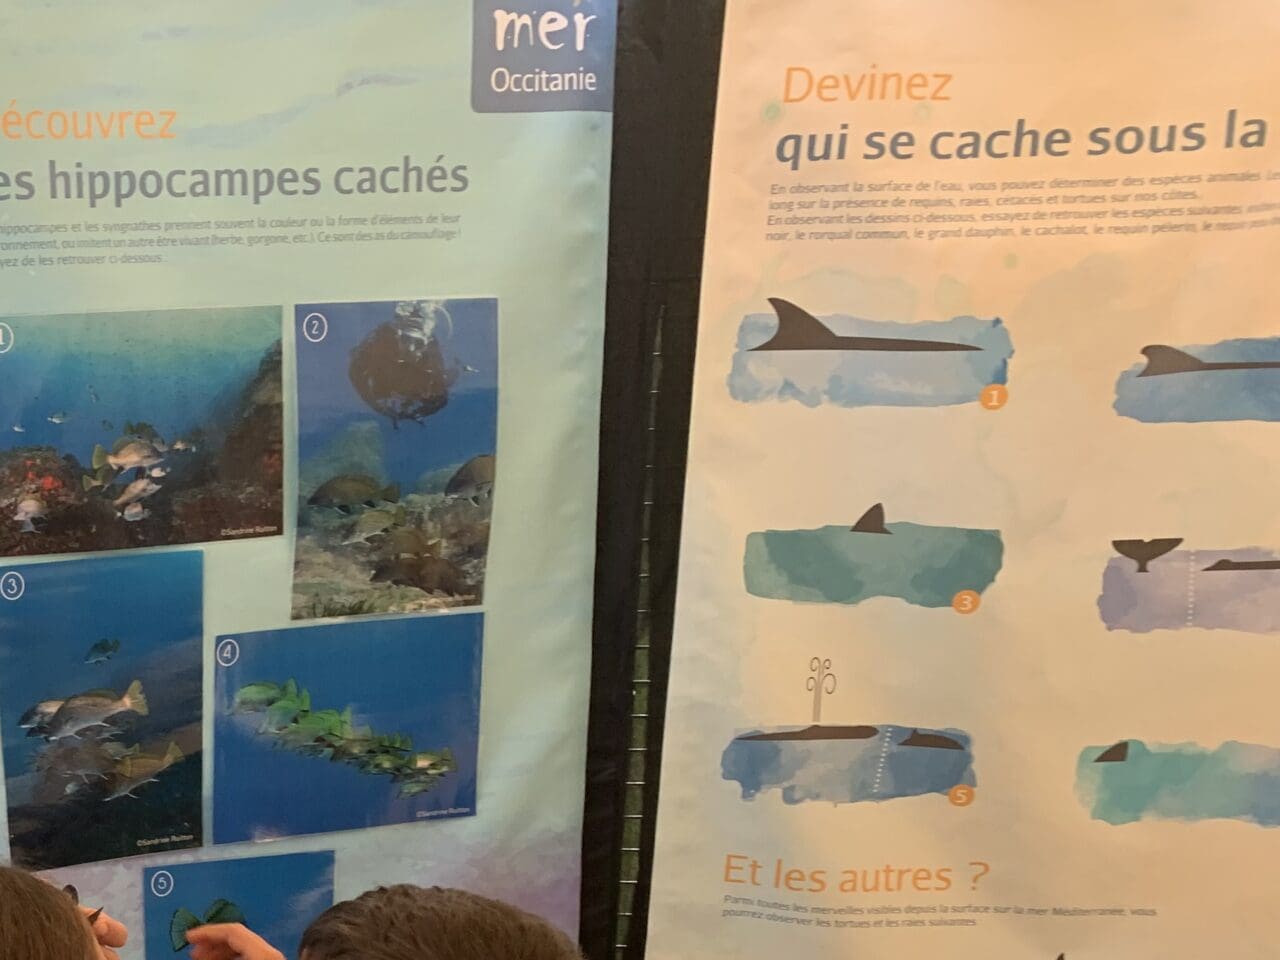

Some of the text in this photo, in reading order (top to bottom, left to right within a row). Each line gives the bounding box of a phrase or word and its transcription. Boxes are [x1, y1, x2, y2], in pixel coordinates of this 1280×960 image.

[493, 9, 597, 51] mer
[490, 66, 597, 92] Occitanie
[783, 63, 953, 103] Devinez
[775, 109, 1268, 171] qui se cache sous la
[48, 160, 321, 208] hippocampes
[333, 154, 469, 194] cachés
[723, 853, 990, 893] Et les autres ?
